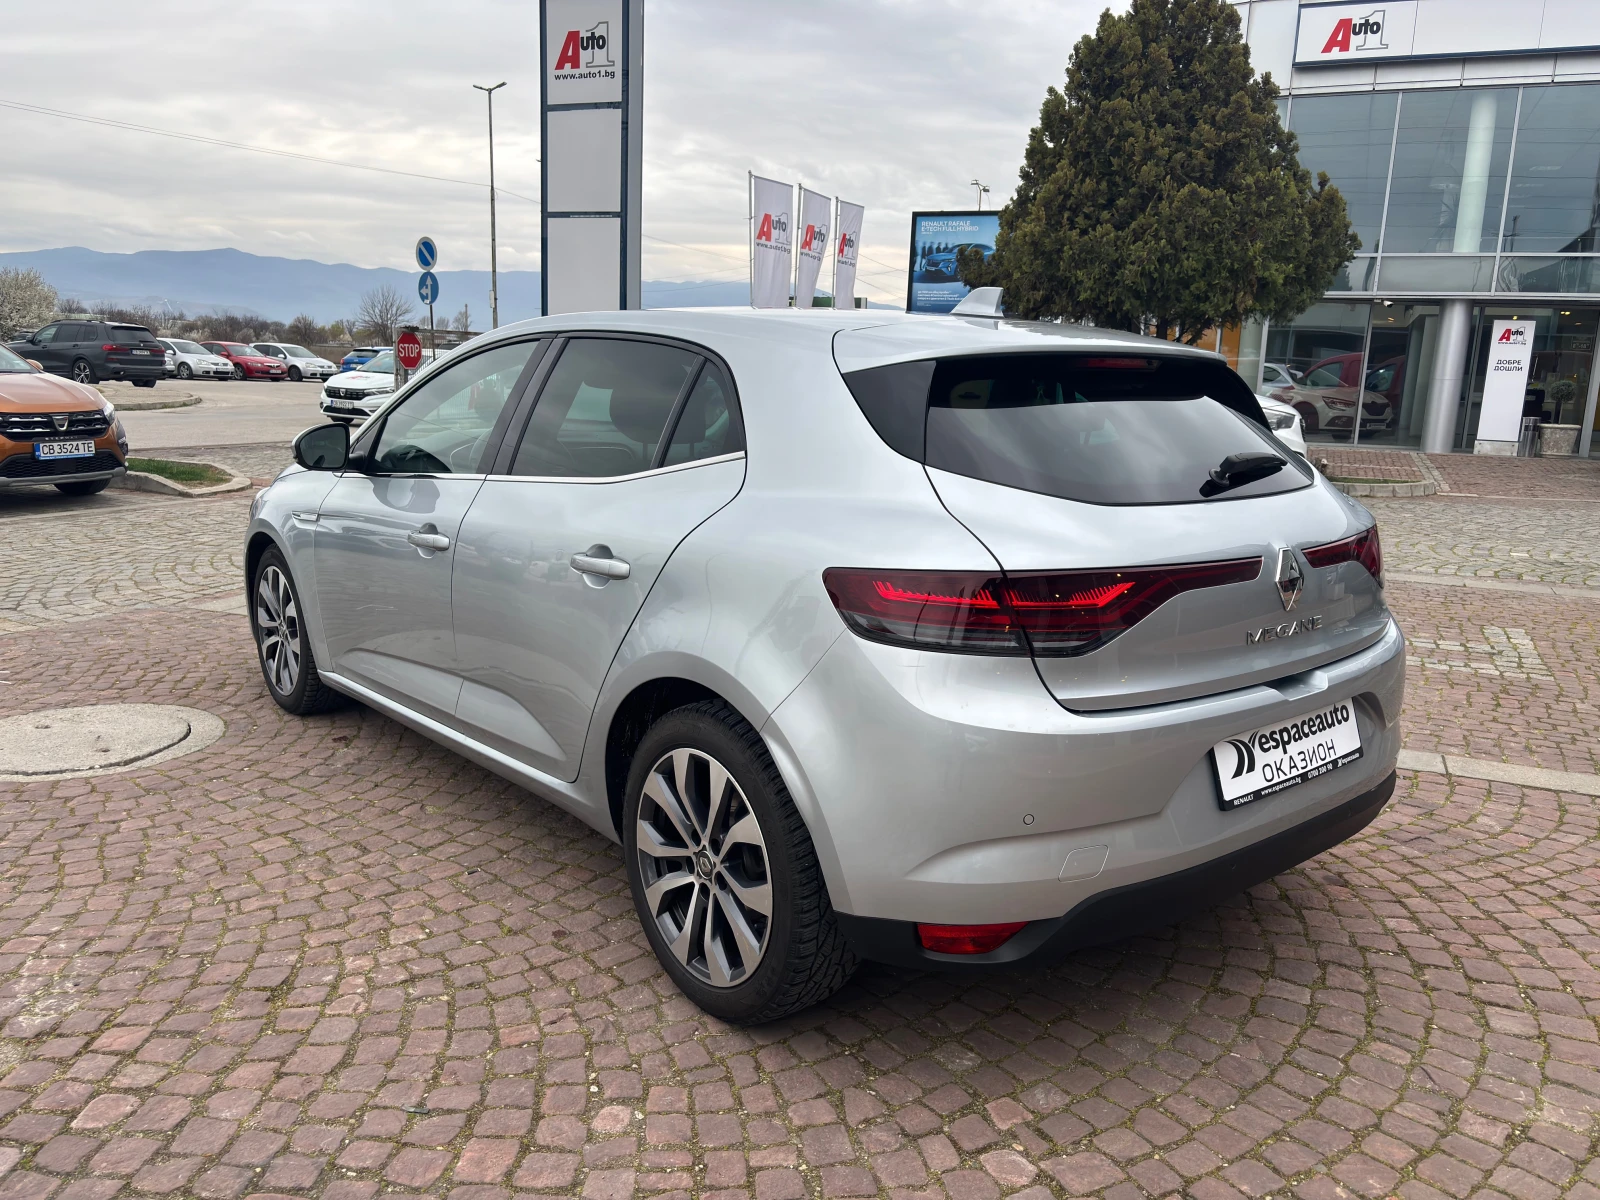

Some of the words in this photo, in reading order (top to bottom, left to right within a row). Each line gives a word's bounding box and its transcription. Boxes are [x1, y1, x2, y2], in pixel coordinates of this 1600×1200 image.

[554, 70, 615, 80] www.auto1.bg
[398, 344, 420, 357] STOP
[57, 443, 80, 454] 3524
[81, 442, 93, 452] TE
[1246, 615, 1322, 646] MEGANE
[1258, 703, 1350, 755] espaceauto
[1262, 739, 1337, 783] ОКАЗИОН
[1233, 794, 1254, 806] RENAULT
[1261, 777, 1301, 796] www.espaceauto.bg
[1307, 768, 1318, 779] 0700
